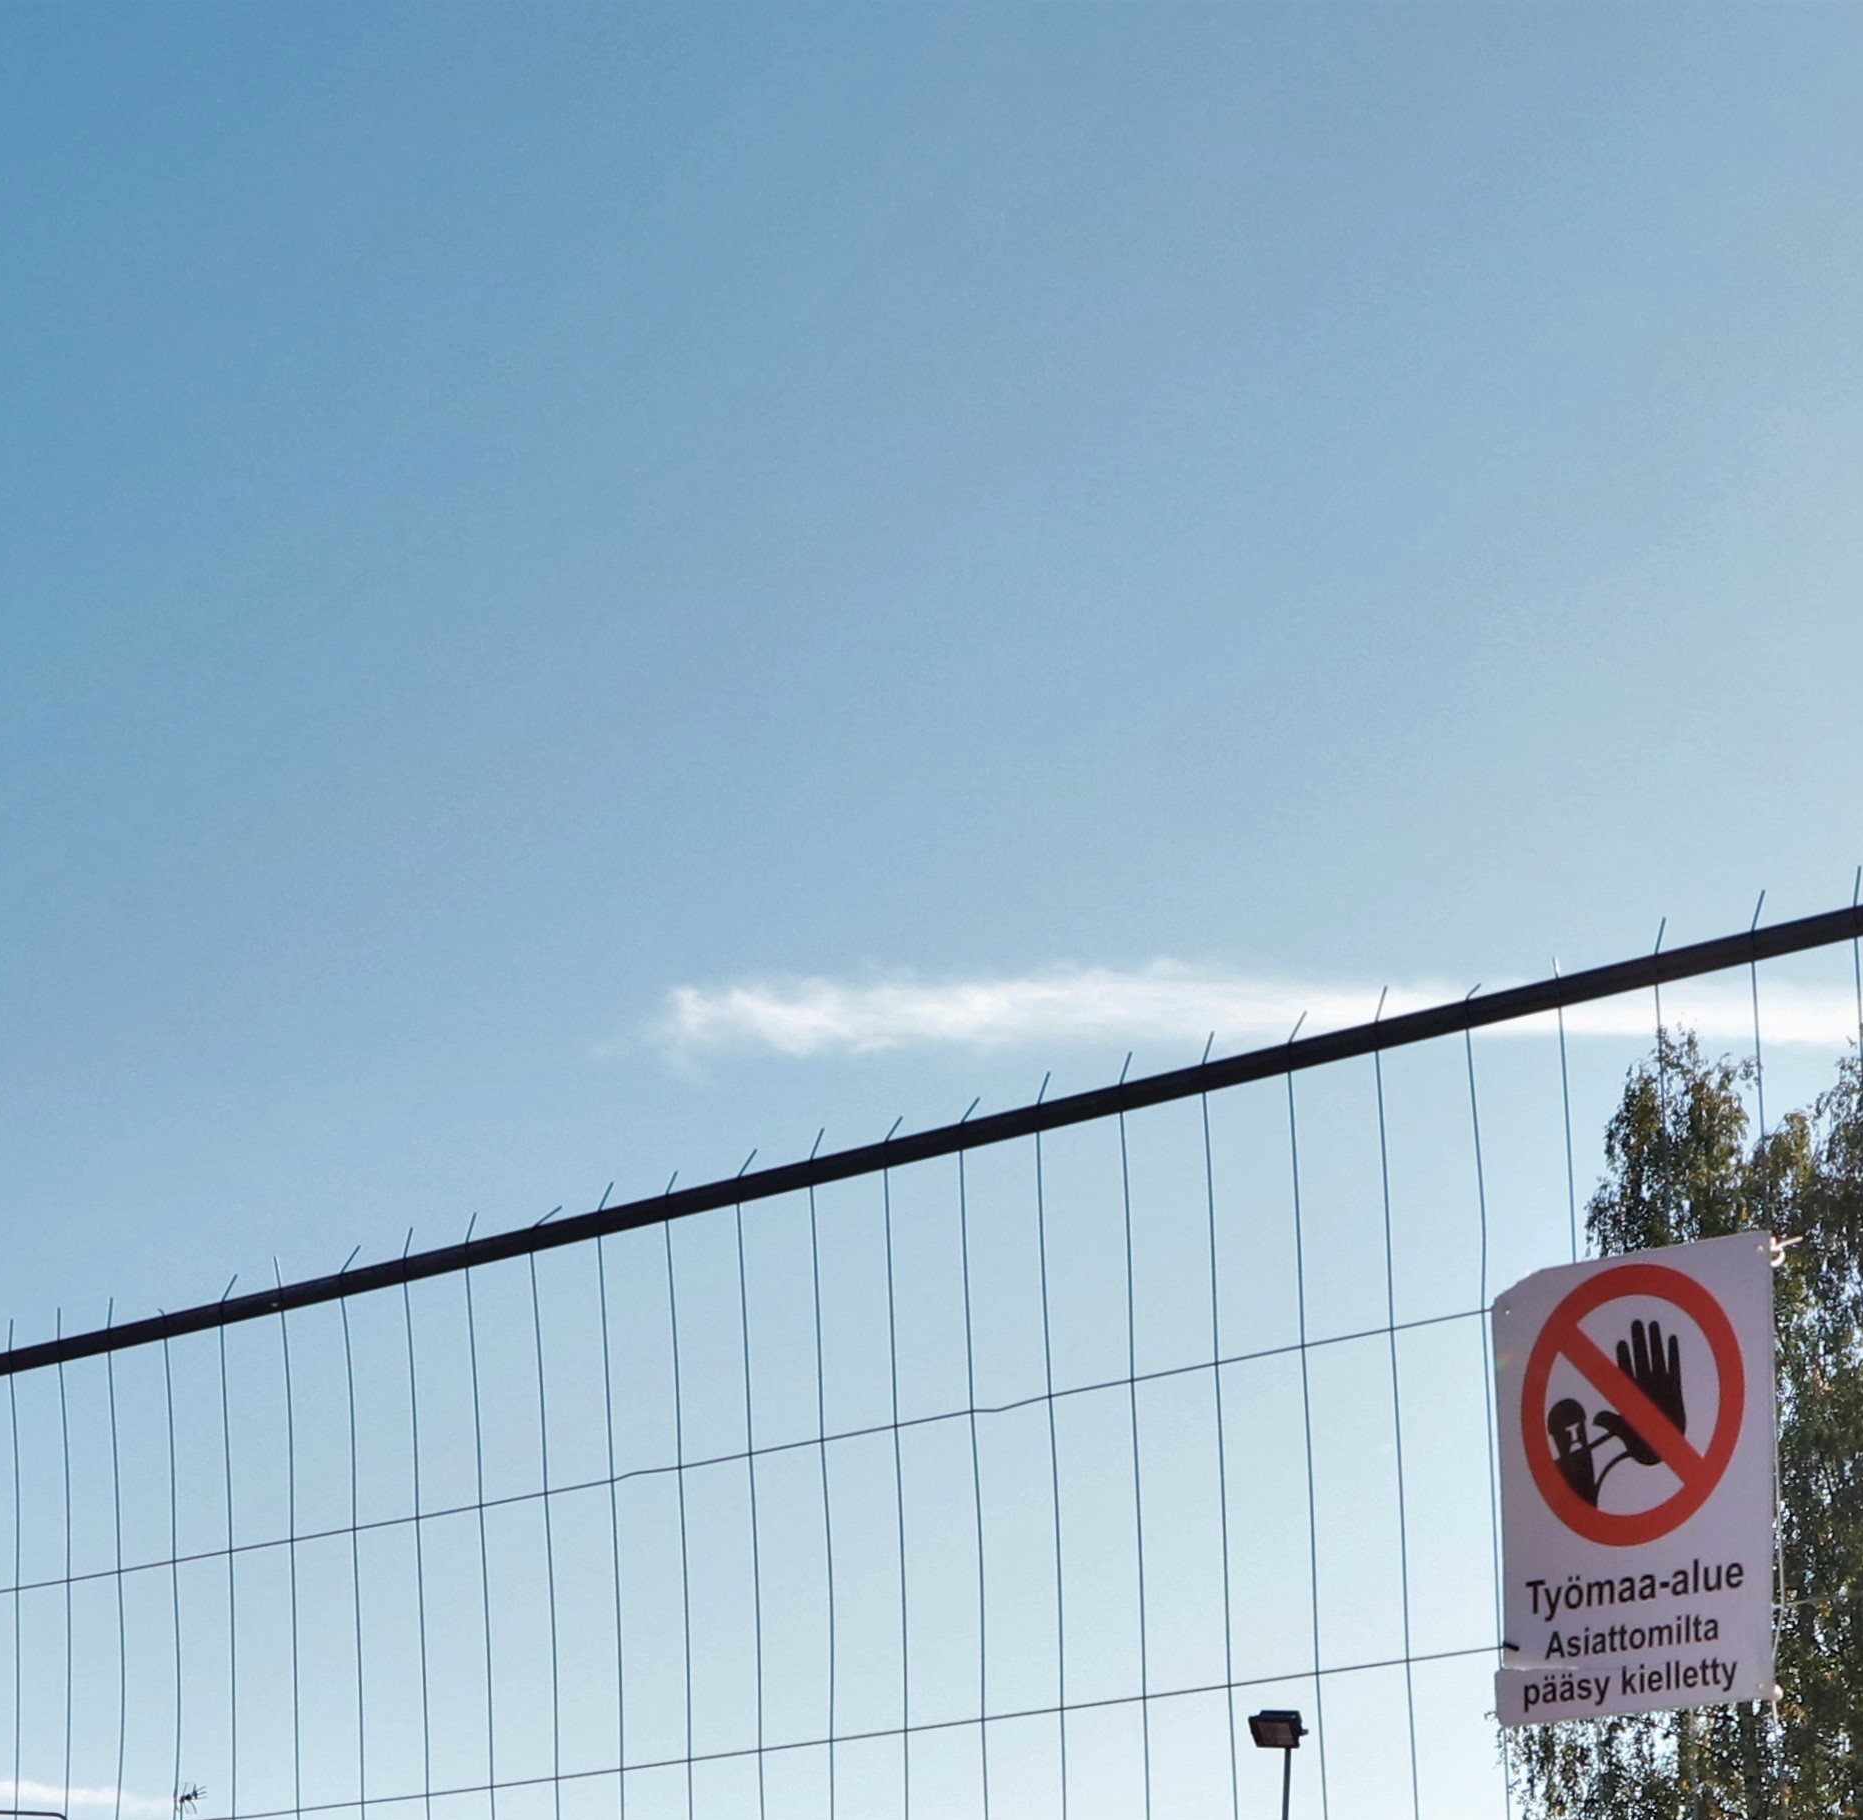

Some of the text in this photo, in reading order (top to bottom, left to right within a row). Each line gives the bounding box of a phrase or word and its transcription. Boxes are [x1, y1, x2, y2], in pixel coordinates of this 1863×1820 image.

[1526, 1559, 1745, 1622] Työmaa-alue
[1545, 1614, 1719, 1660] Asiattomilta
[1523, 1657, 1738, 1713] pääsy kielletty
